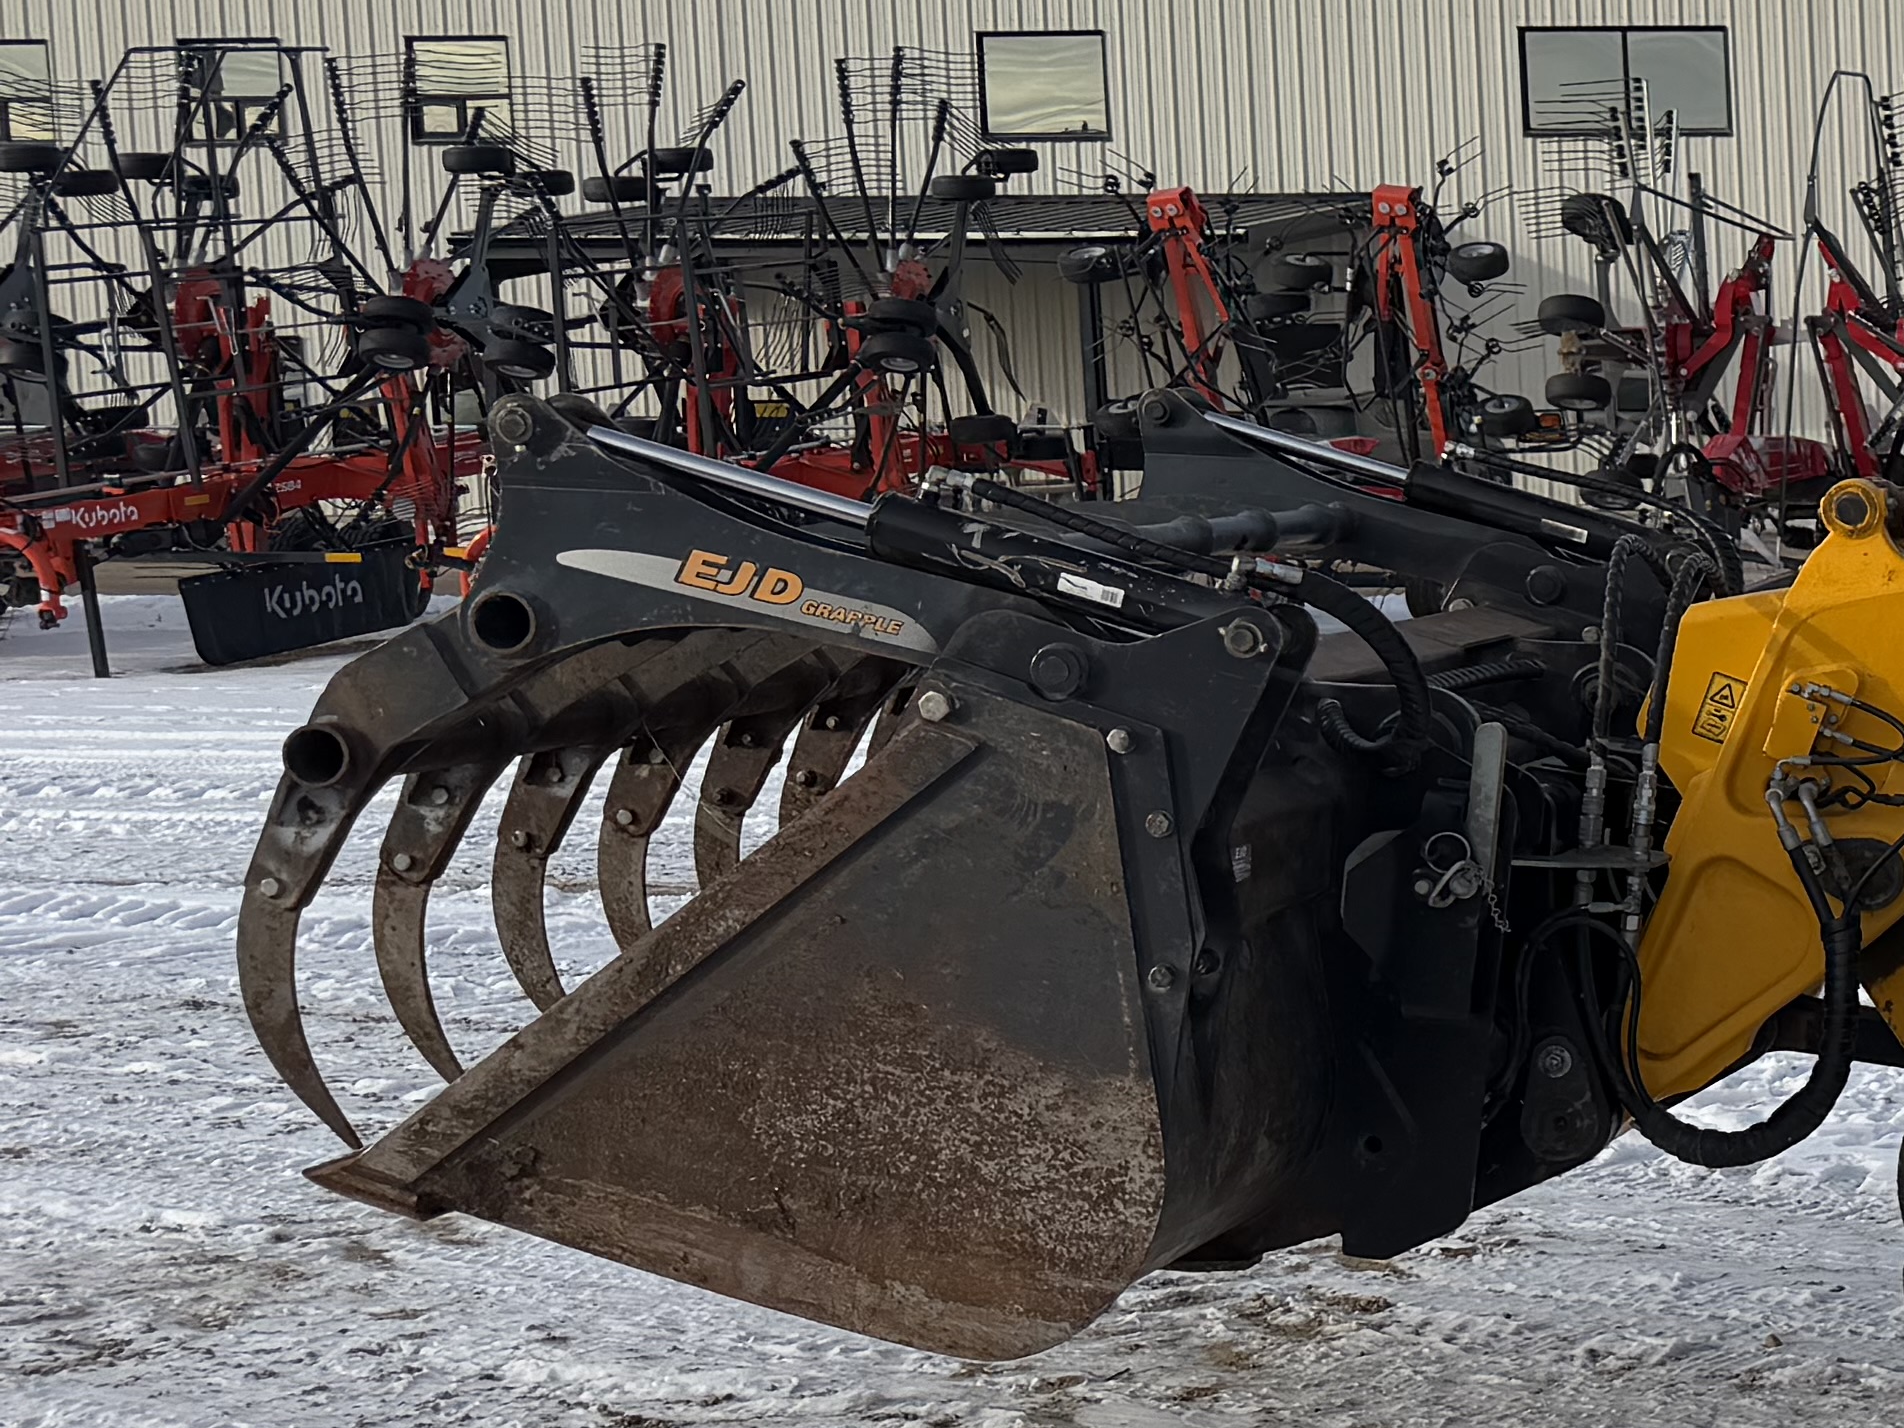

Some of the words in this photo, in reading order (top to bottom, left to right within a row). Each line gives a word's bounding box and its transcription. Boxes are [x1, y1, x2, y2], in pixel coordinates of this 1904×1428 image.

[71, 501, 139, 529] Kubota
[264, 573, 364, 620] Kubota
[675, 549, 804, 605] EJD
[800, 600, 905, 636] GRAPPLE
